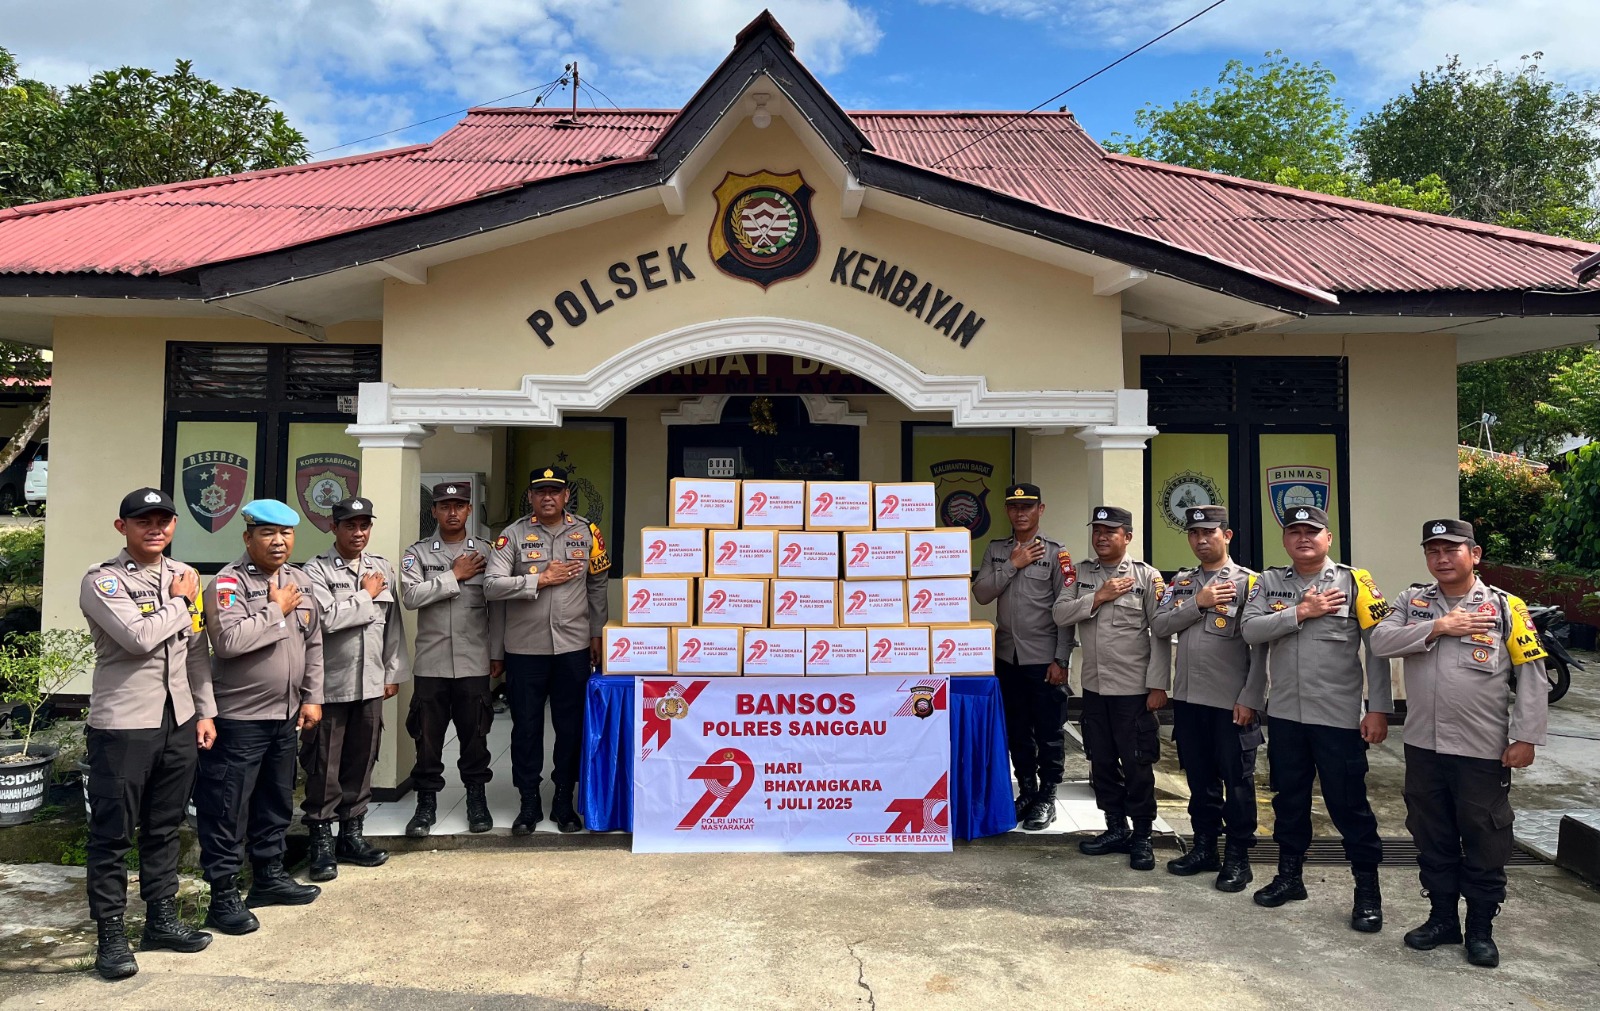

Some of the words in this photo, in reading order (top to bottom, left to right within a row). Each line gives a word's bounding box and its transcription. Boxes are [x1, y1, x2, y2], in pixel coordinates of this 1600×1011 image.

[526, 243, 696, 347] POLSEK
[830, 246, 985, 348] KEMBAYAN
[190, 452, 242, 466] RESERSE
[300, 457, 324, 466] KORPS
[324, 457, 356, 468] SABHARA
[933, 463, 970, 474] KALIMANTAN
[970, 464, 990, 474] BARAT
[1275, 470, 1322, 479] BINMAS
[736, 692, 856, 715] BANSOS
[703, 720, 782, 737] POLRES
[788, 720, 887, 736] SANGGAU
[764, 763, 802, 774] HARI
[764, 779, 882, 792] BHAYANGKARA
[764, 798, 771, 810] 1
[777, 798, 812, 810] JULI
[817, 798, 852, 810] 2025
